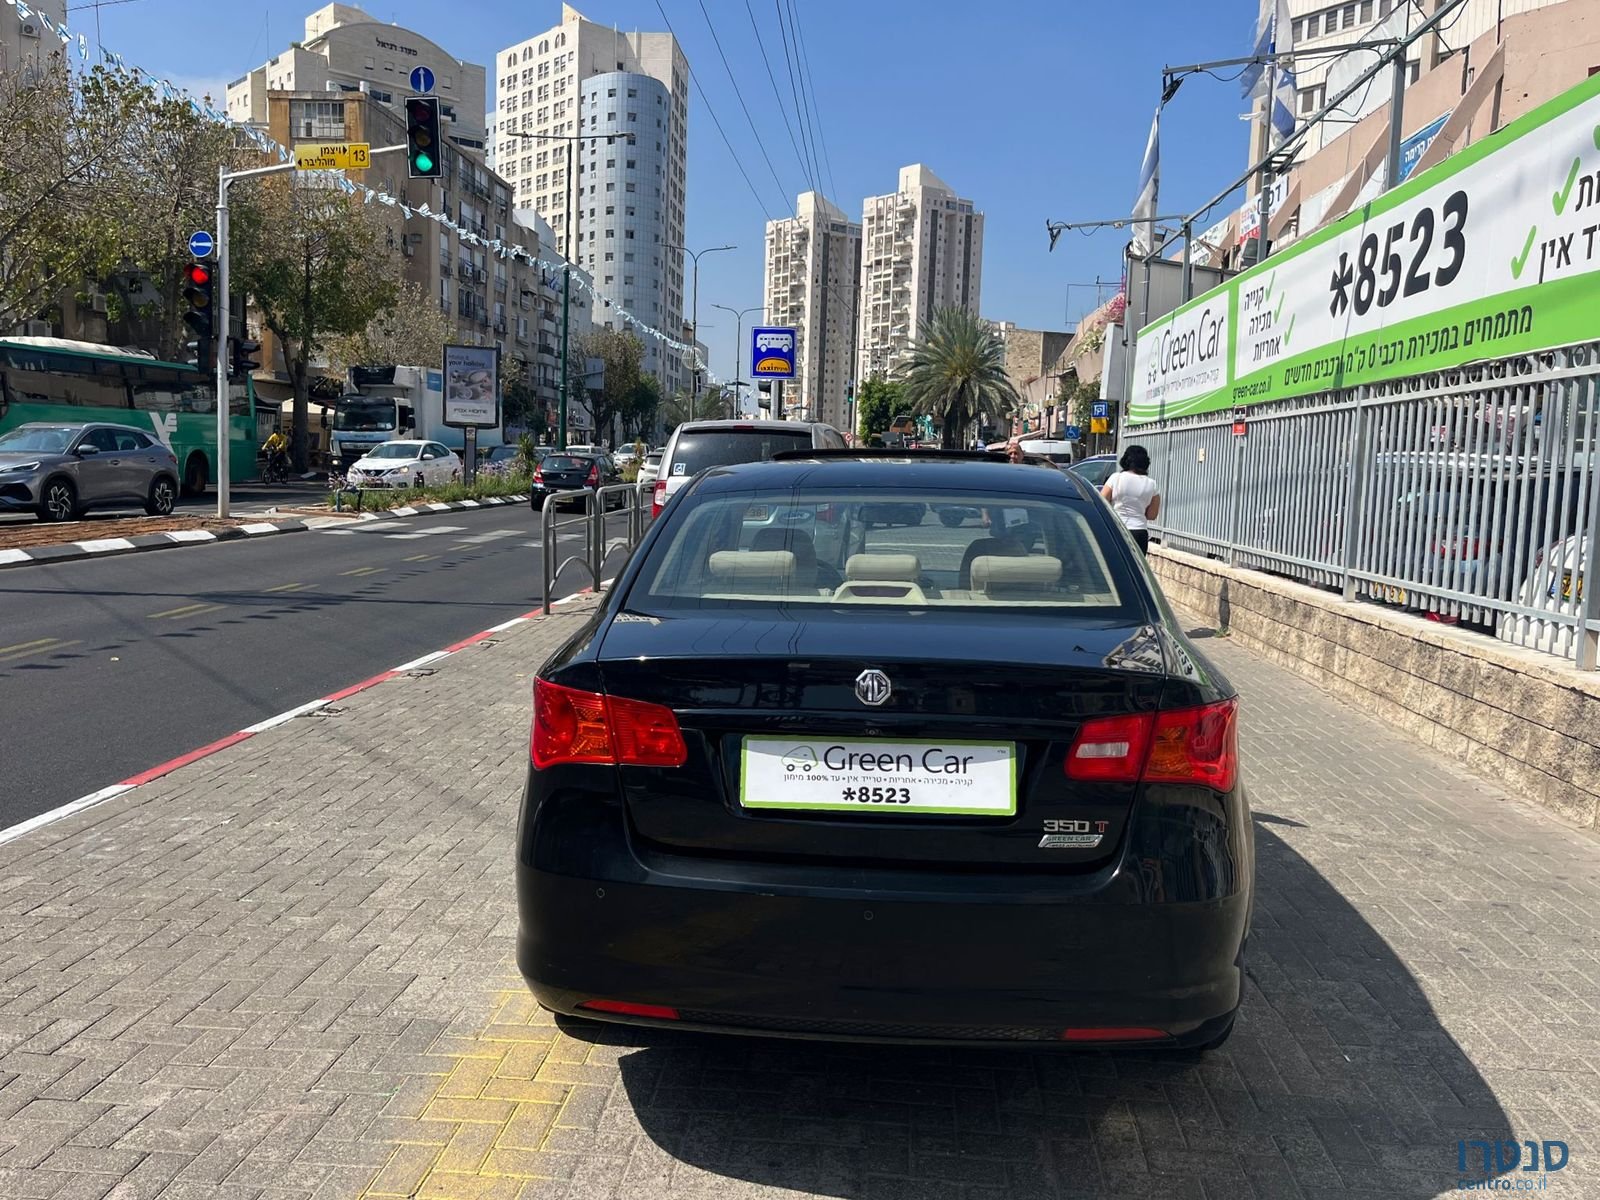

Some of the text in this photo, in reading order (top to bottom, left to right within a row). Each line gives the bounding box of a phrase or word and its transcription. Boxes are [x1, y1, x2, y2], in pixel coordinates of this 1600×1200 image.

[320, 146, 366, 162] ויצמן 13
[1538, 232, 1574, 284] אין
[1244, 286, 1264, 311] קנייה
[1249, 311, 1271, 336] מכירה
[1463, 305, 1533, 346] מתמחים
[1160, 308, 1224, 375] Green Car
[1253, 335, 1281, 361] אחריות
[1379, 336, 1403, 366] רכבי
[1406, 325, 1459, 361] במכירת
[1368, 343, 1376, 369] 0
[1284, 362, 1312, 386] חדשים
[1233, 375, 1272, 402] green-car.co.il
[857, 671, 889, 703] MG
[823, 745, 974, 774] Green Car
[783, 774, 804, 782] מימון
[847, 775, 859, 784] אין
[861, 775, 882, 783] טרייד
[889, 776, 917, 784] אחריות
[923, 777, 948, 785] מכירה
[954, 778, 973, 786] קניה
[1043, 819, 1109, 833] 350 T
